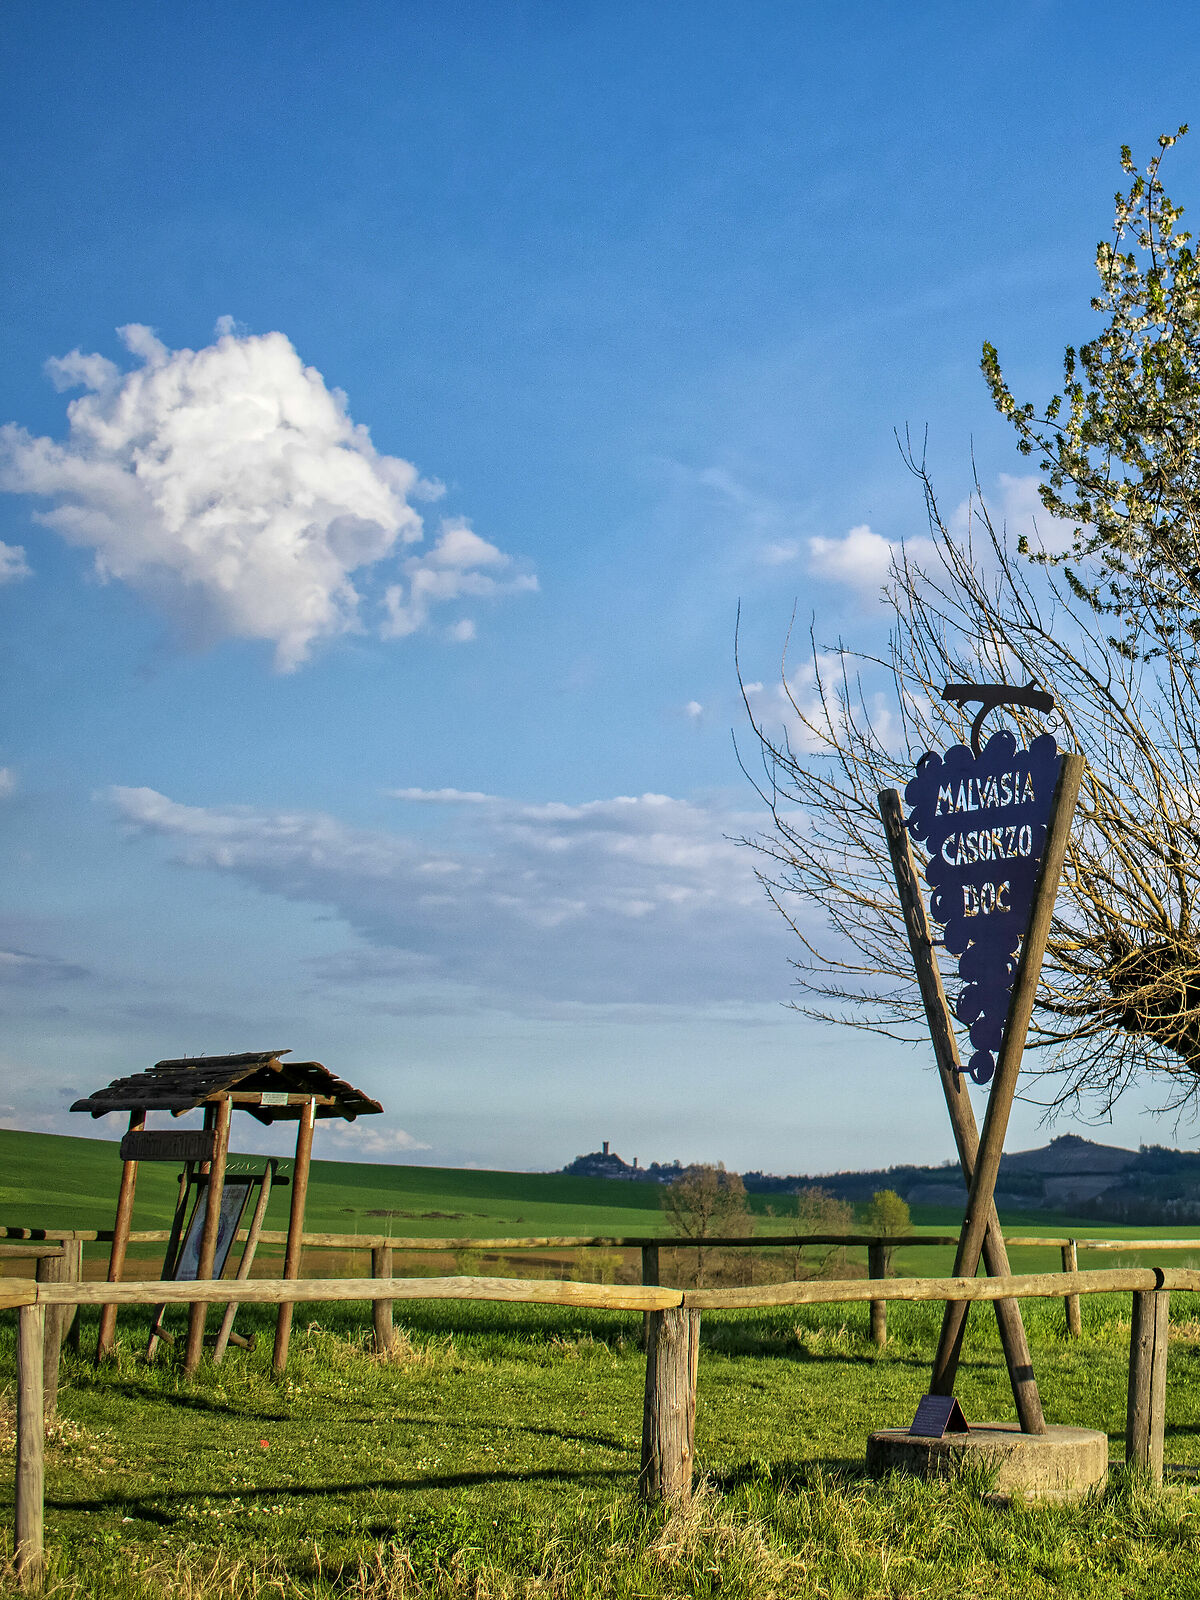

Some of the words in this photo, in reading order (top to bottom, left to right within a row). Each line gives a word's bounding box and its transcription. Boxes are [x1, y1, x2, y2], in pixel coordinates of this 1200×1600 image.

[935, 771, 1035, 816] MALVASIA
[941, 825, 1032, 866] CASORZO
[962, 880, 1011, 918] DOC
